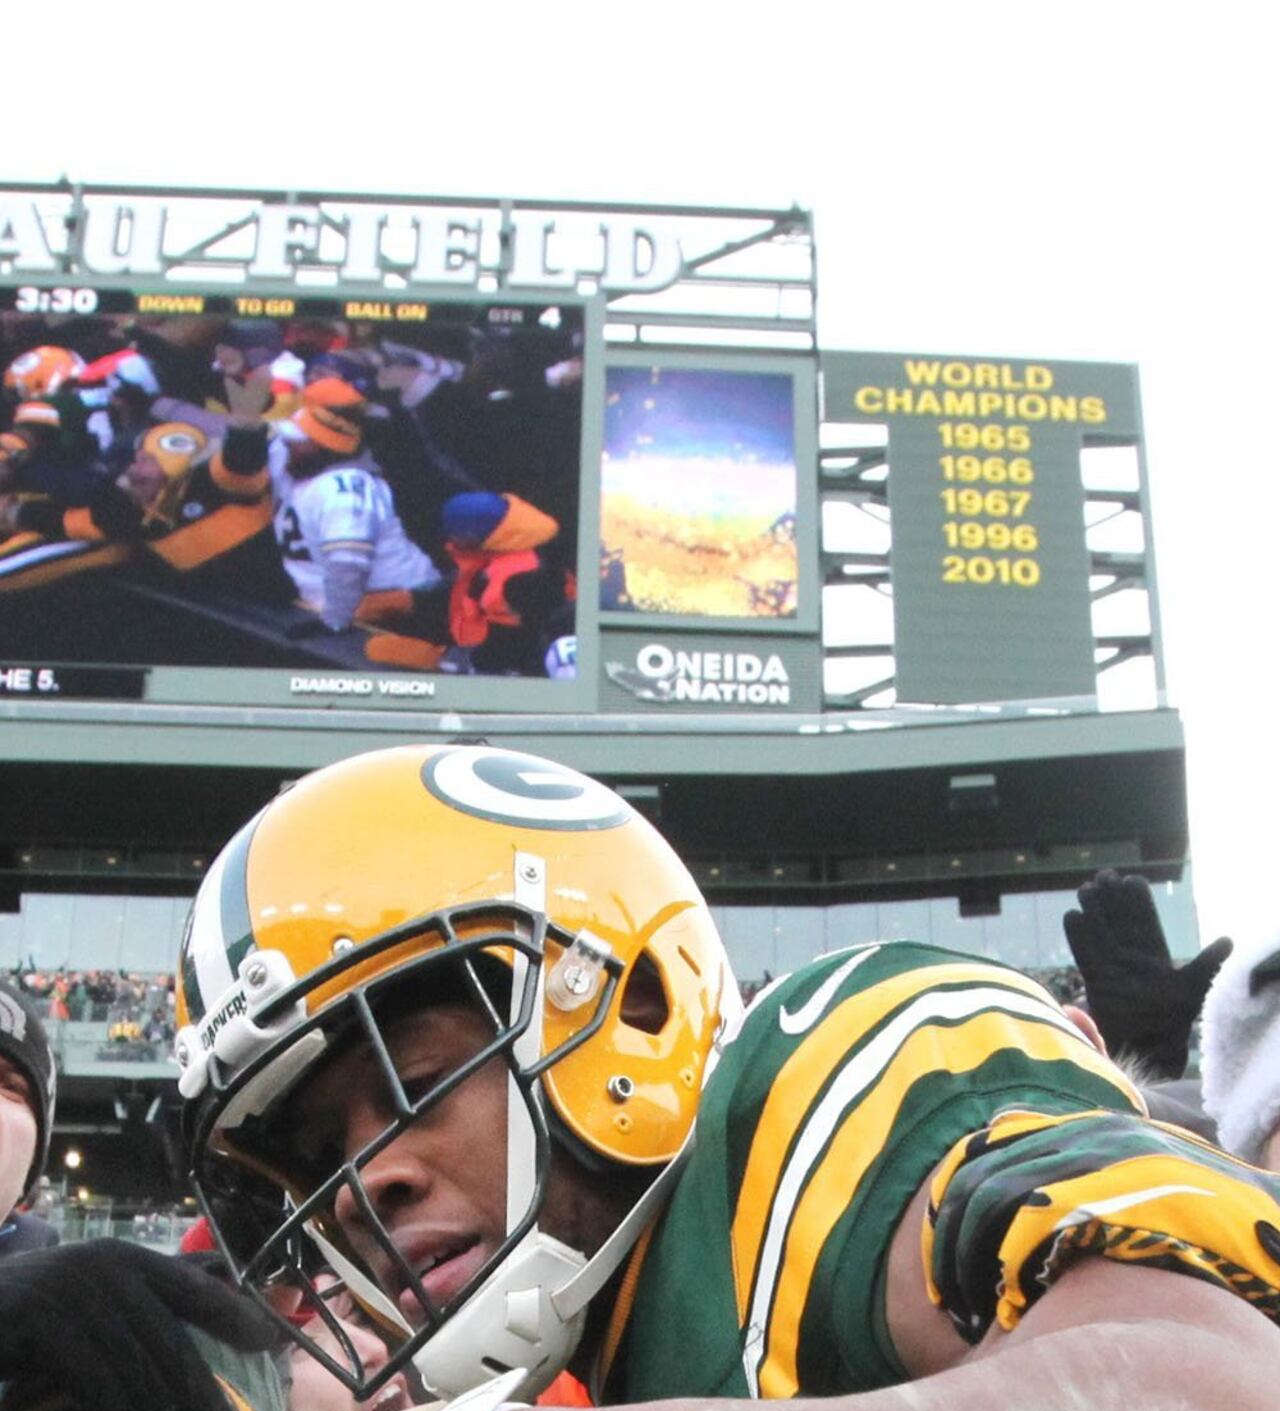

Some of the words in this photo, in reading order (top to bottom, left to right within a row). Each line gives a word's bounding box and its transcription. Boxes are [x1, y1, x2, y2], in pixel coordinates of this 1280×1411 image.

[249, 203, 681, 293] FIELD
[15, 287, 98, 314] 3:30
[137, 294, 204, 315] DOWN
[235, 297, 262, 316] TO
[265, 298, 295, 316] GO
[345, 301, 392, 320] BALL
[396, 303, 428, 322] ON
[538, 306, 561, 330] 4
[905, 360, 1053, 391] WORLD
[854, 386, 1107, 423] CHAMPIONS
[938, 422, 1031, 451] 1965
[939, 455, 1034, 484] 1966
[940, 488, 1032, 517] 1967
[943, 521, 1038, 551] 1996
[942, 555, 1040, 586] 2010
[636, 643, 789, 683] ONEIDA
[290, 676, 373, 694] DIAMOND
[377, 679, 435, 695] VISION
[674, 678, 790, 704] NATION
